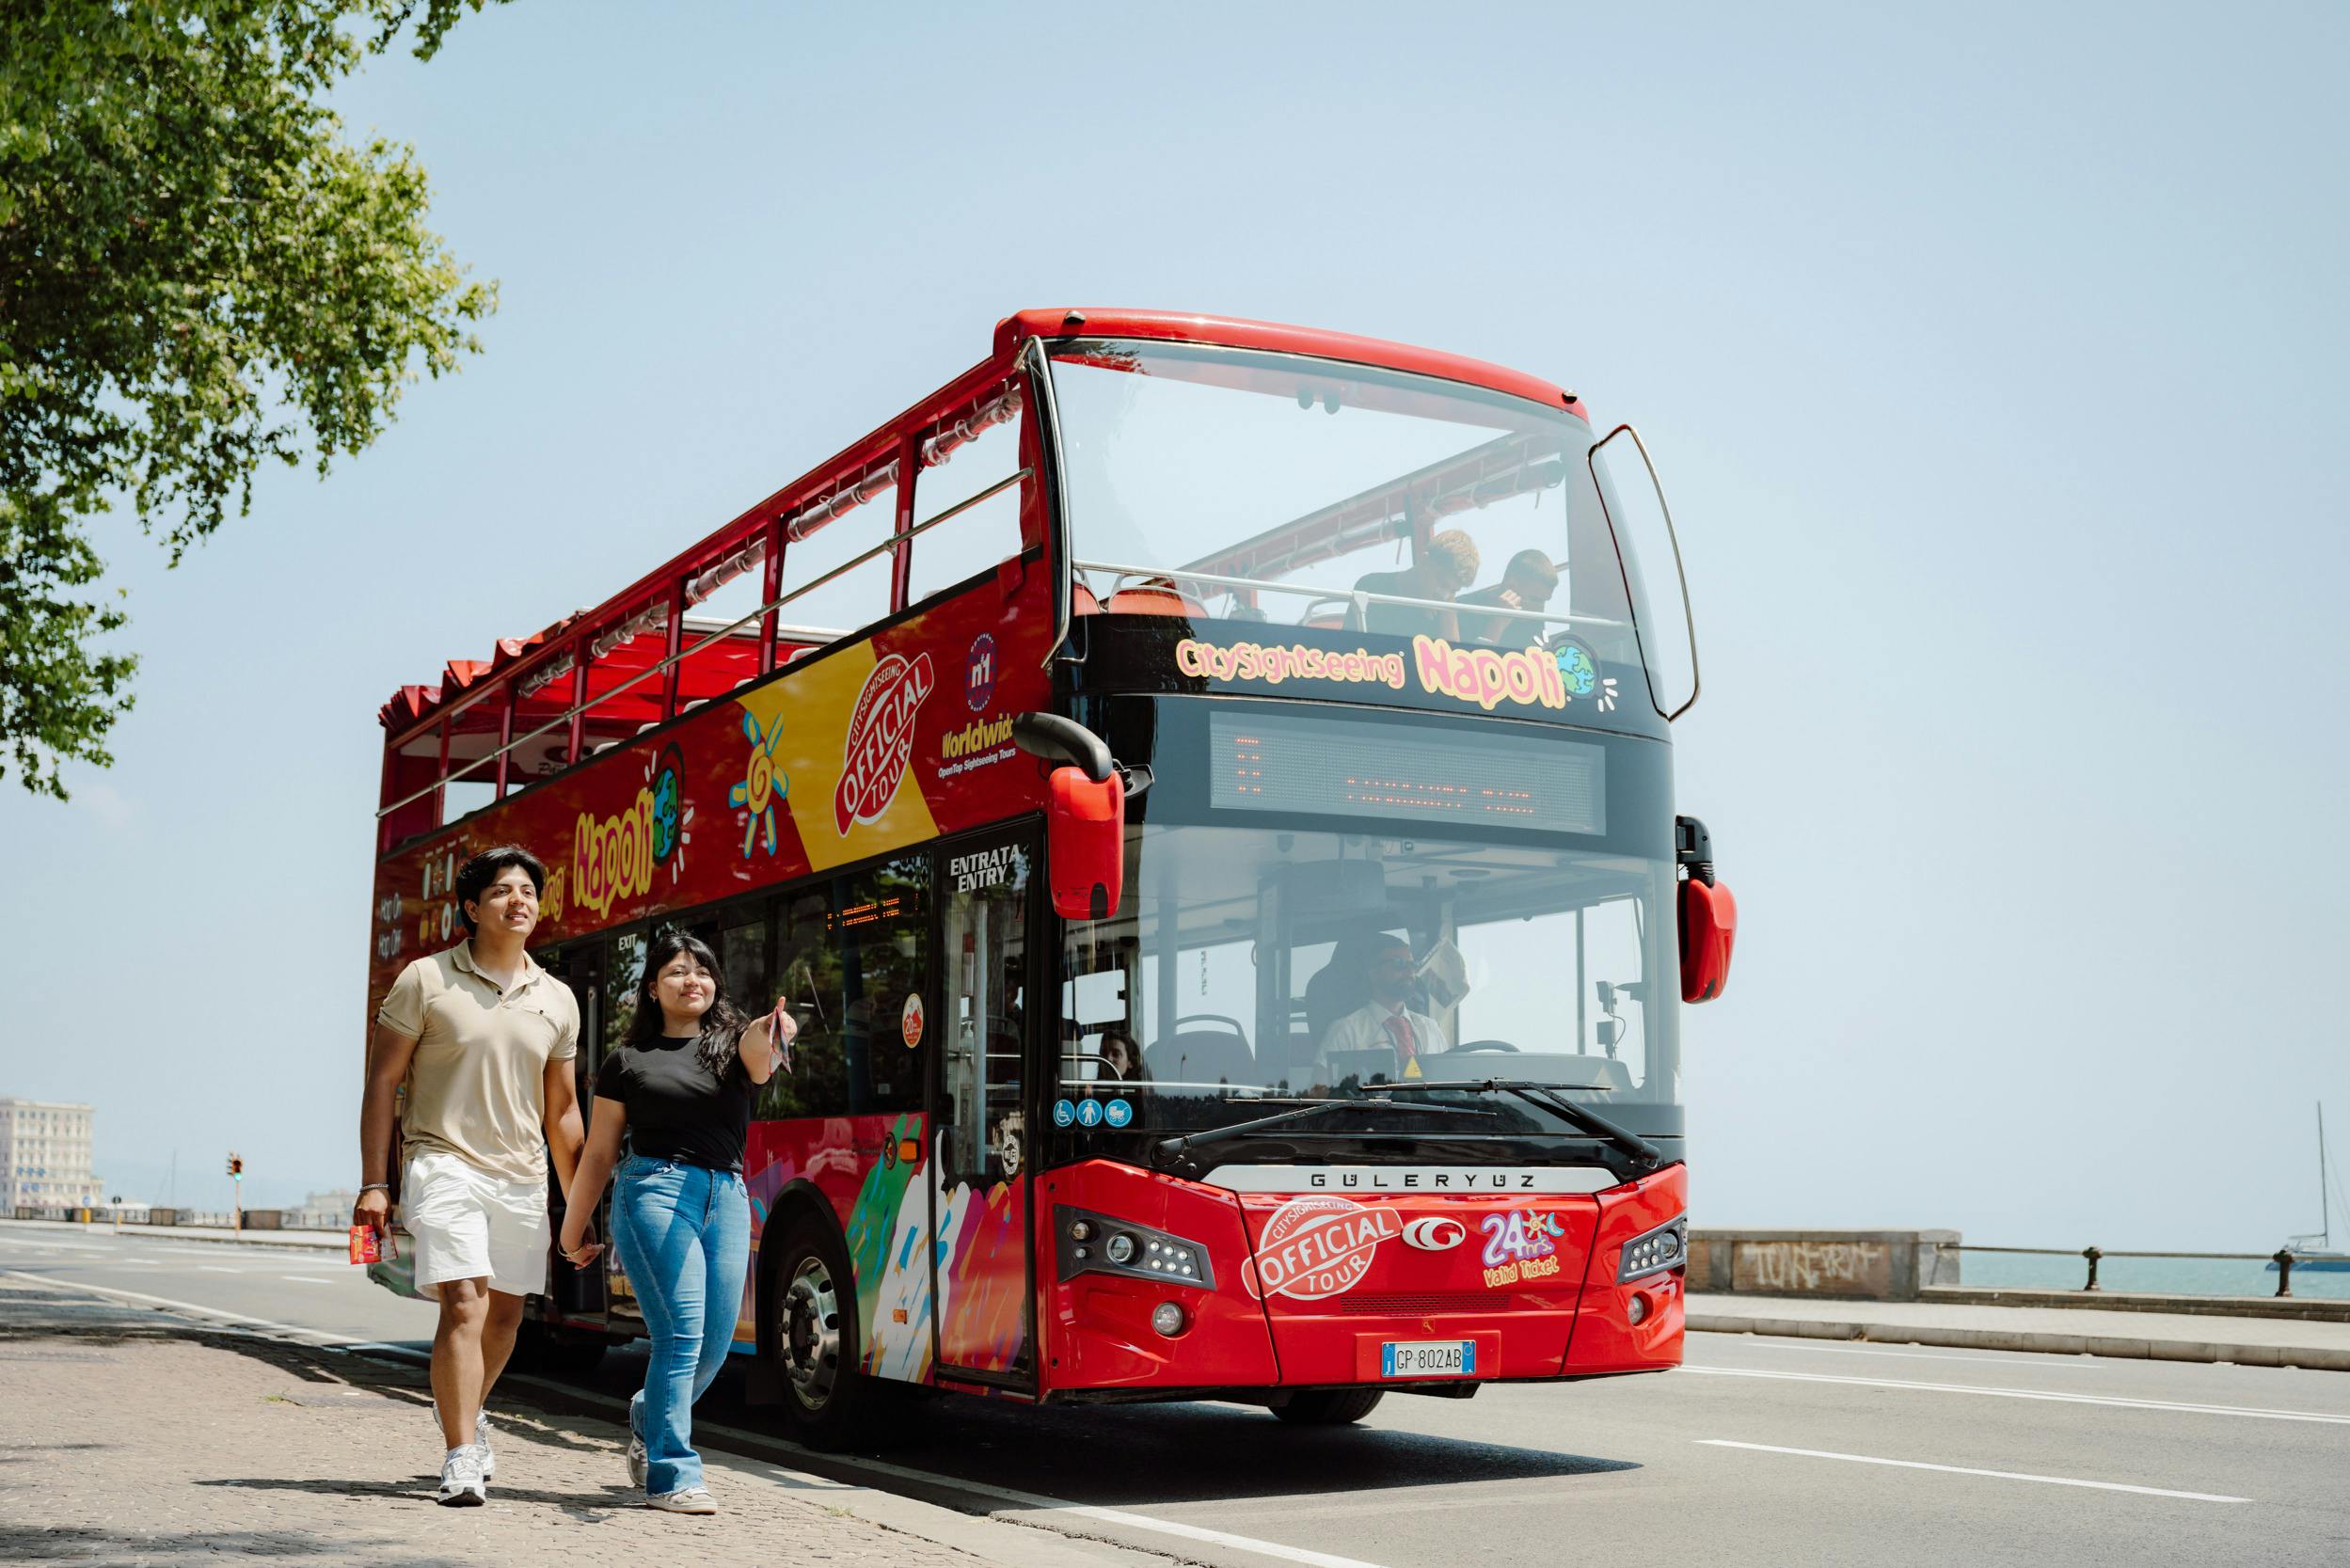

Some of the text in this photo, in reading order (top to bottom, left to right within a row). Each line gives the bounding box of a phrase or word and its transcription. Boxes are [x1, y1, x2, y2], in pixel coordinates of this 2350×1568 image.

[1176, 634, 1565, 710] CitySightseeing Napoli
[851, 662, 901, 746] CITYSIGHTSEEING
[844, 666, 928, 813] OFFICIAL
[871, 737, 909, 808] TOUR
[963, 752, 998, 770] Sightseeing
[998, 748, 1016, 759] Tours
[573, 787, 655, 920] Napoli
[950, 844, 1020, 876] ENTRATA
[958, 864, 1008, 893] ENTRY
[618, 933, 638, 951] EXIT
[1310, 1173, 1533, 1188] GÜLERYÜZ
[1272, 1201, 1353, 1240] CITYSIGHTSEEING
[1260, 1212, 1394, 1285] OFFICIAL
[1308, 1254, 1366, 1292] TOUR
[1484, 1255, 1561, 1288] Valid Ticket
